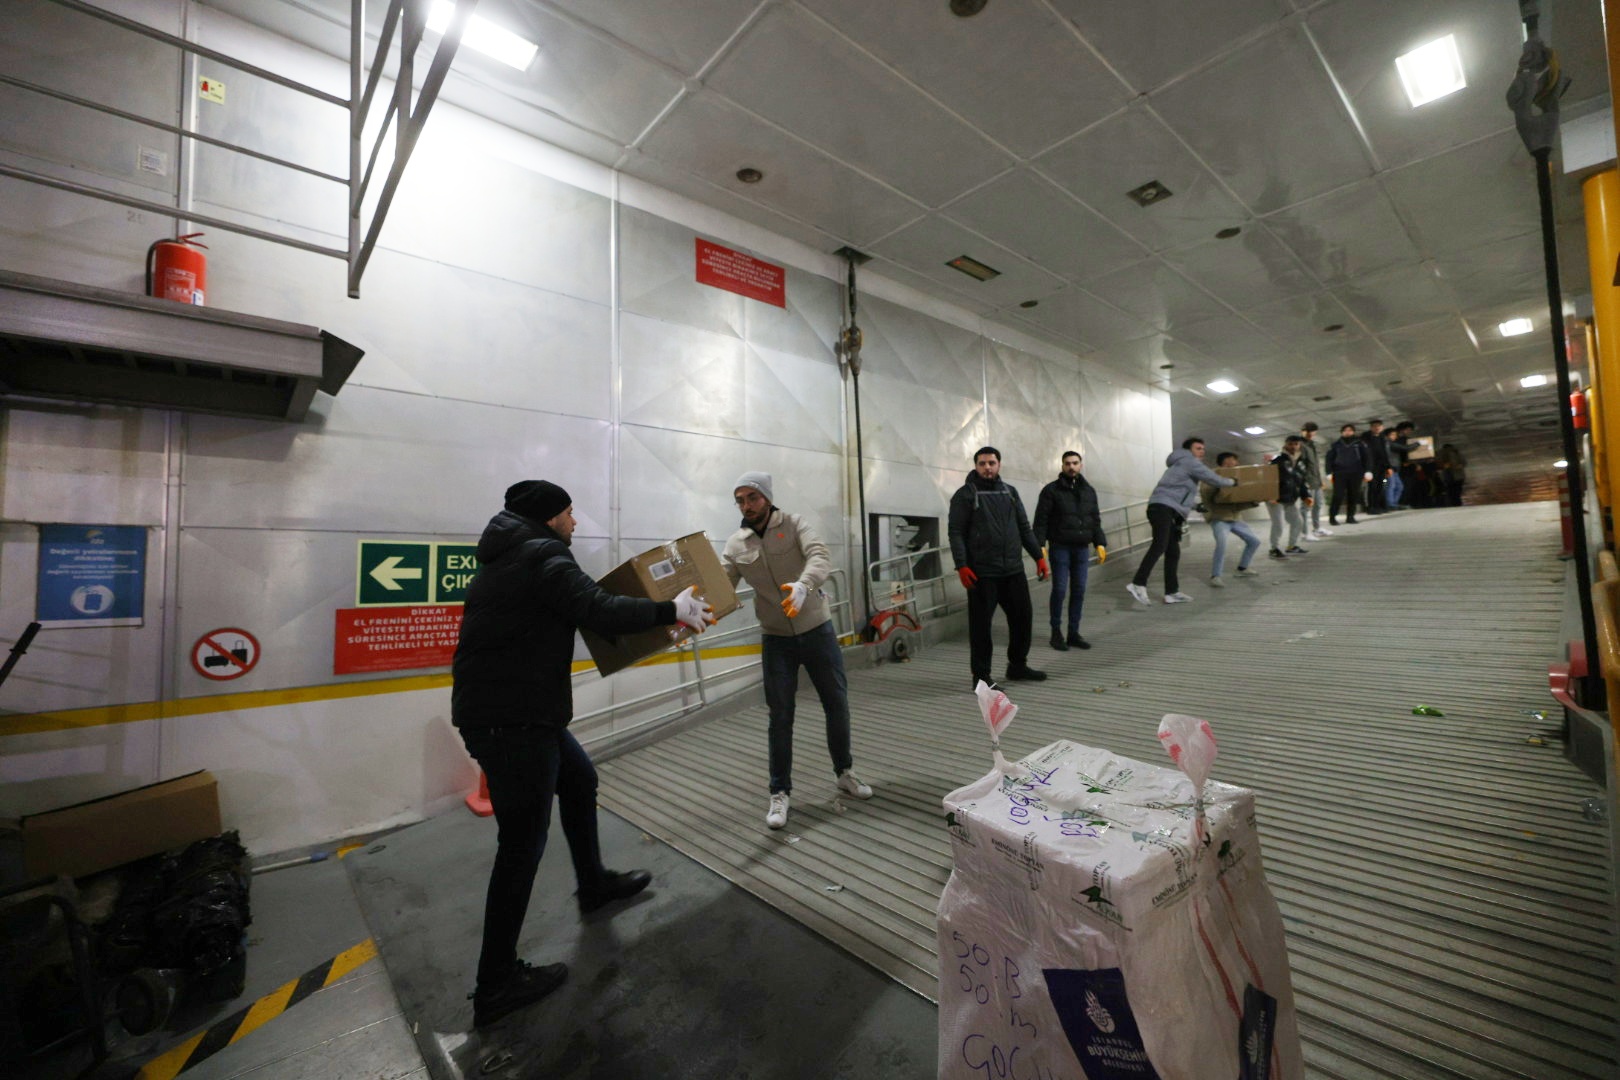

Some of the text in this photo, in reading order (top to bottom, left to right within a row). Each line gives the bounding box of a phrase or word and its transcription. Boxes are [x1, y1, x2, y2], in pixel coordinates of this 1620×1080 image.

[447, 555, 477, 569] EXI
[441, 574, 475, 592] ÇIK
[411, 607, 448, 617] DİKKAT
[353, 619, 367, 627] EL
[369, 616, 412, 626] FRENİNİ
[414, 614, 452, 625] ÇEKİNİZ
[363, 622, 459, 635] VİTESTE BIRAKINIZ
[347, 633, 407, 645] SÜRESİNCE
[409, 631, 447, 641] ARAÇTA
[368, 641, 421, 651] TEHLİKELİ
[423, 639, 436, 648] VE
